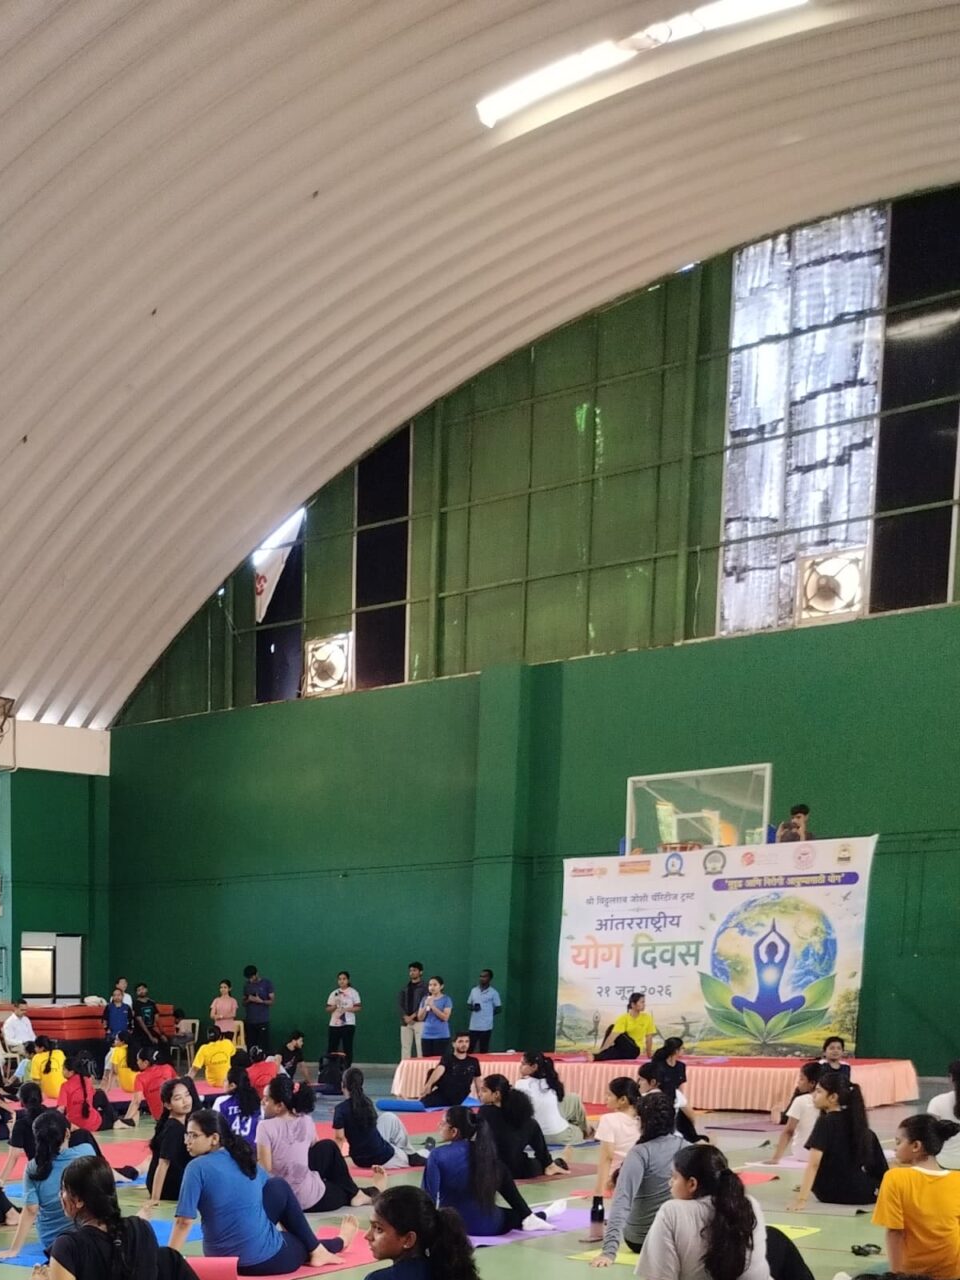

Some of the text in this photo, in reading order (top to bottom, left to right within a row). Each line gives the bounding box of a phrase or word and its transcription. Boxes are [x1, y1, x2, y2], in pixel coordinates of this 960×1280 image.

[595, 911, 682, 932] आंतरराष्ट्रीय
[570, 932, 704, 969] योग दिवस
[596, 985, 611, 998] २१
